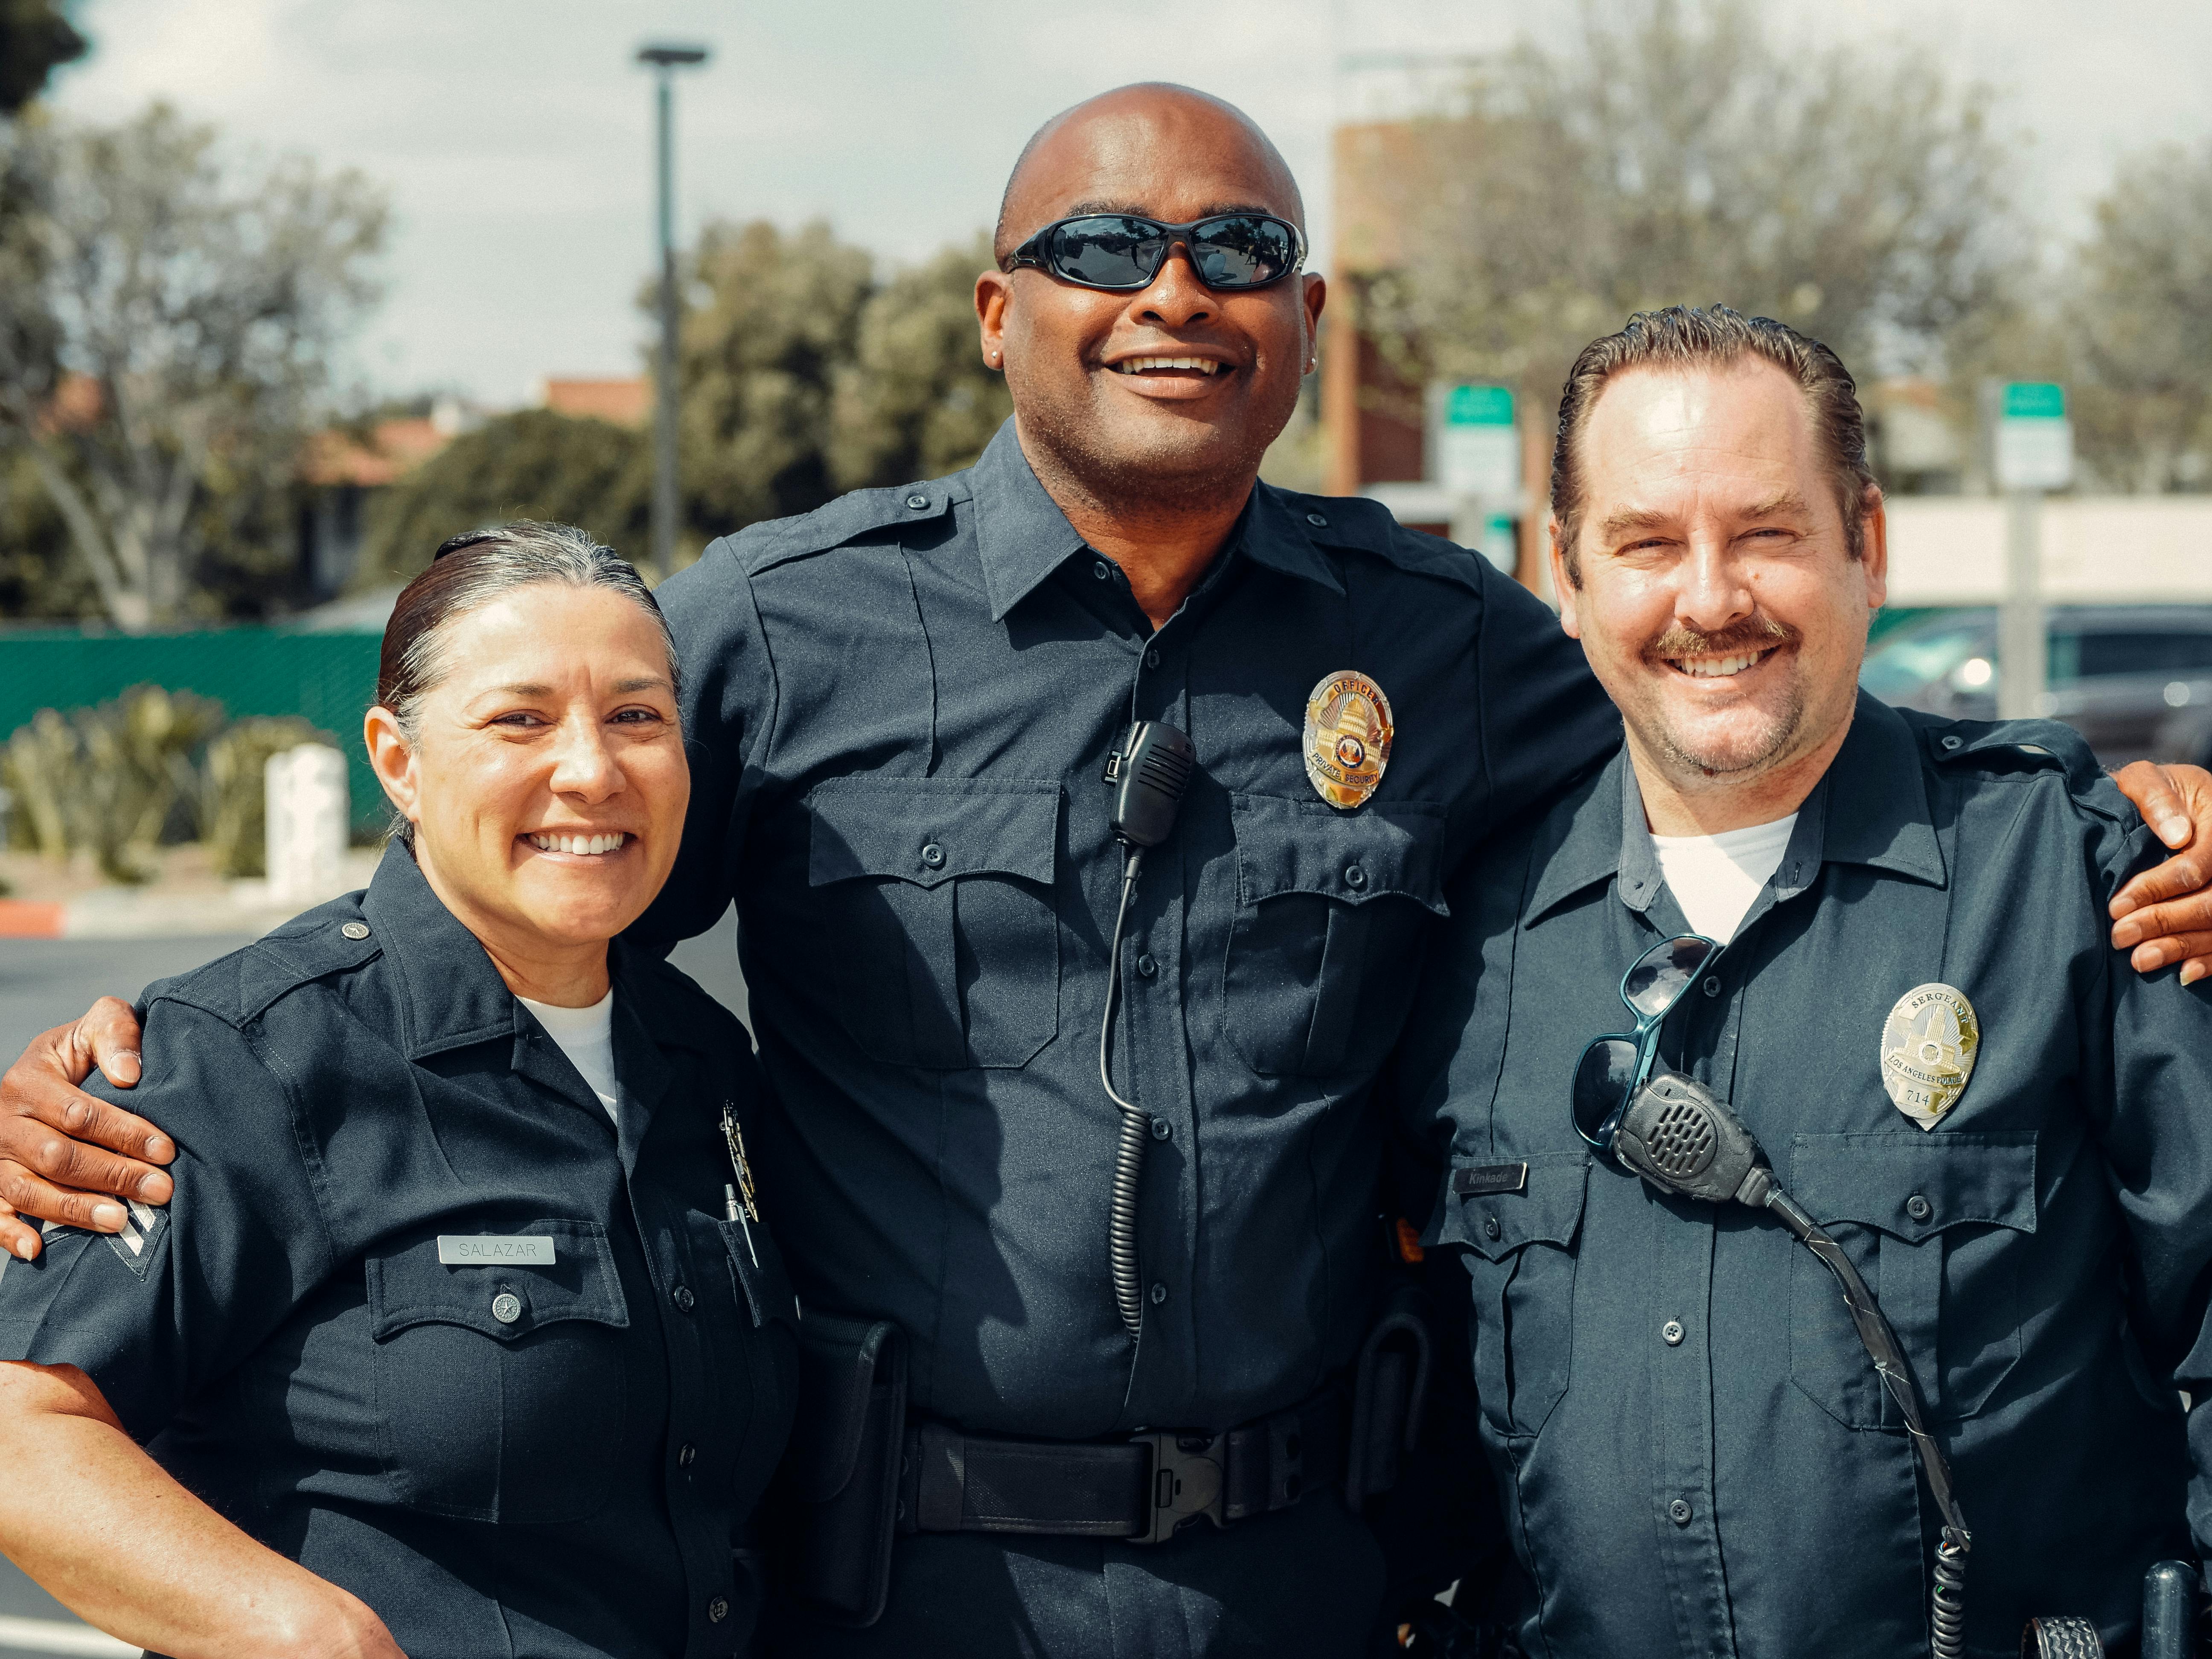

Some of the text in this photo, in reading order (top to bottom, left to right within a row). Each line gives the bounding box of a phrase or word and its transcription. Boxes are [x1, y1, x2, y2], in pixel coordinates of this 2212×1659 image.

[1334, 681, 1379, 705] OFFICER
[1312, 753, 1378, 784] PRIVATE SECURITY
[1912, 992, 1969, 1023] SERGEANT
[1889, 1055, 1962, 1085] LOS ANGELES POLICE
[1908, 1090, 1929, 1106] 714
[1469, 1172, 1508, 1185] Kinkade
[459, 1243, 536, 1256] SALAZAR
